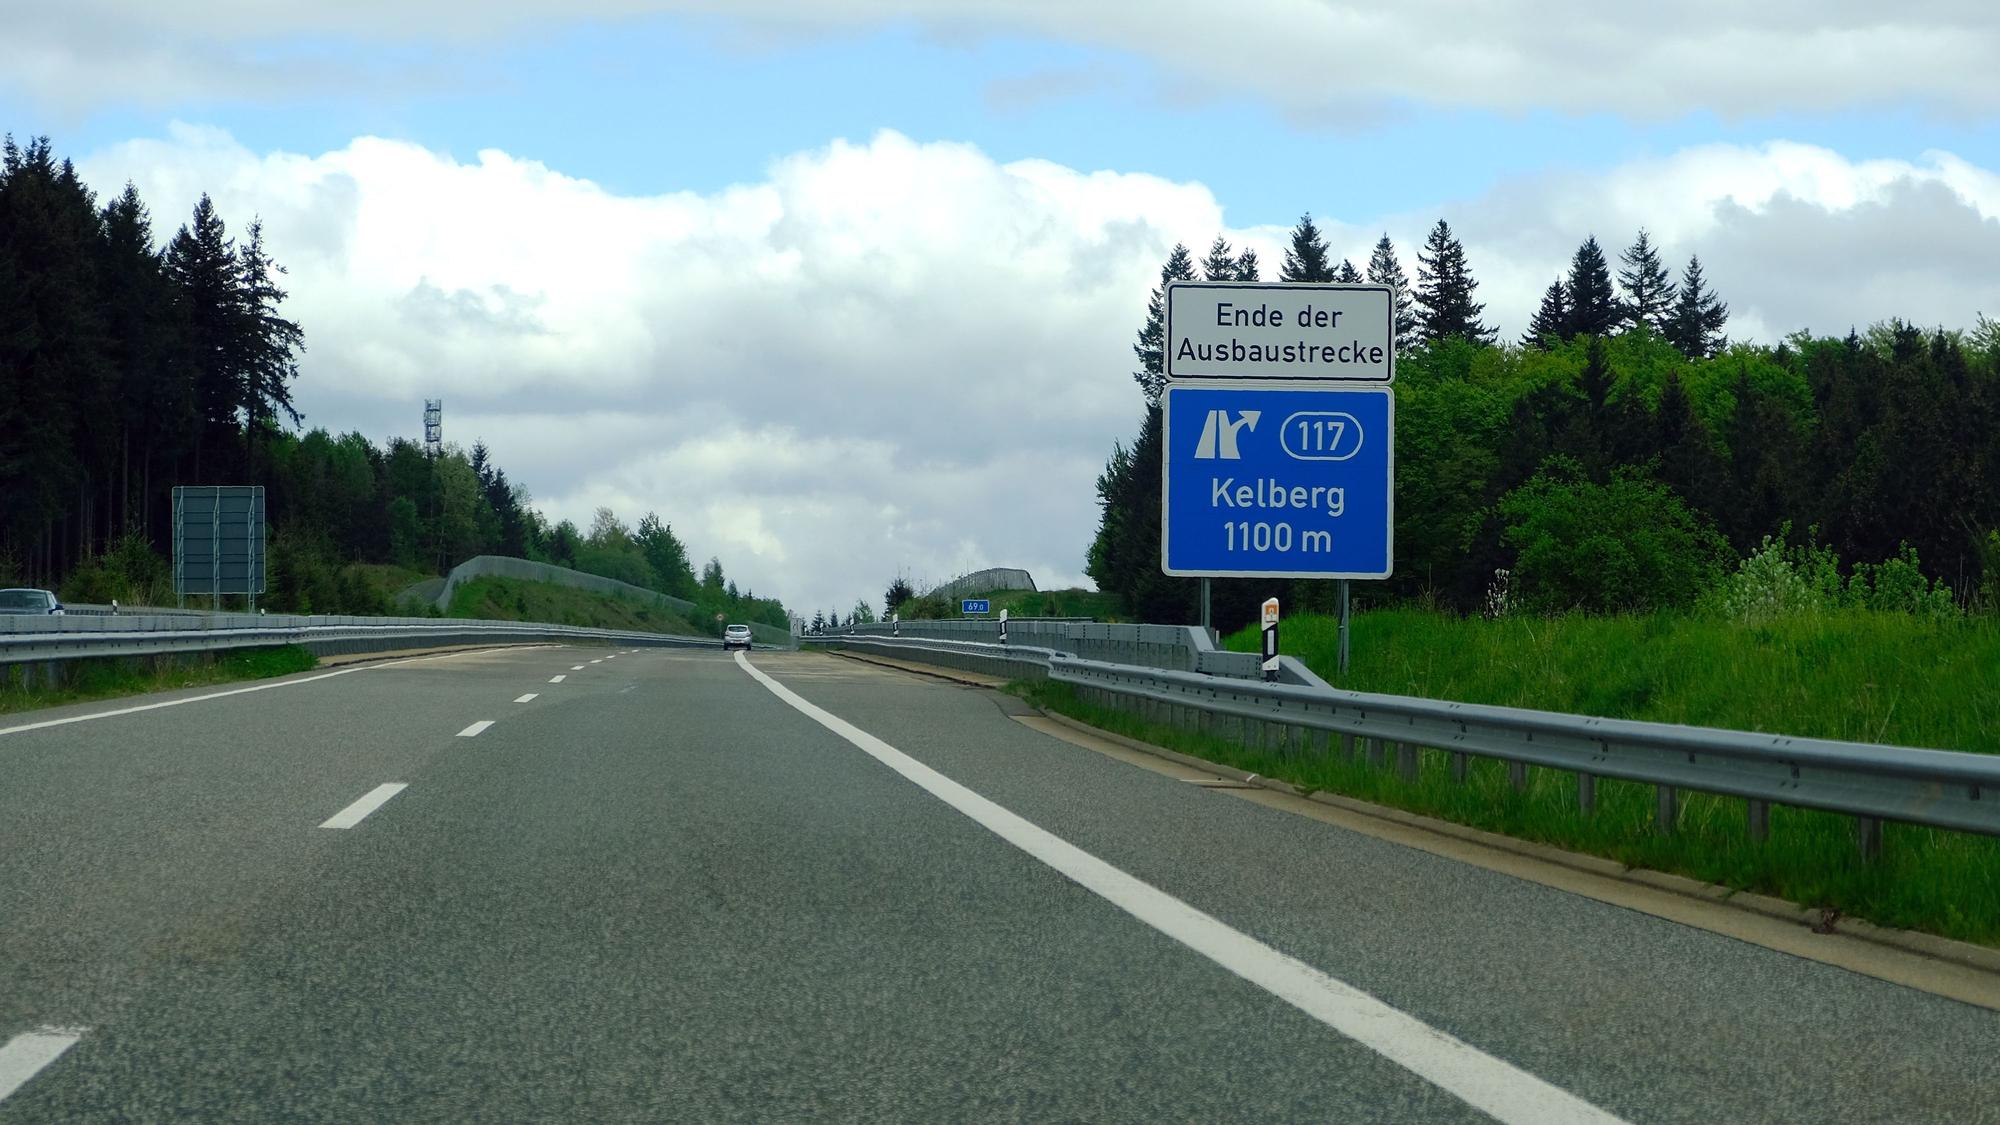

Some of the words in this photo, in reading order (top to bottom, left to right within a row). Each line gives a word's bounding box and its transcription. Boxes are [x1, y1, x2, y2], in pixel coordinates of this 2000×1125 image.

[1217, 303, 1283, 327] Ende
[1297, 304, 1343, 328] der
[1177, 338, 1384, 364] Ausbaustrecke
[1298, 421, 1345, 451] 117
[1212, 478, 1345, 517] Kelberg
[1224, 521, 1292, 552] 1100
[1301, 530, 1332, 553] m
